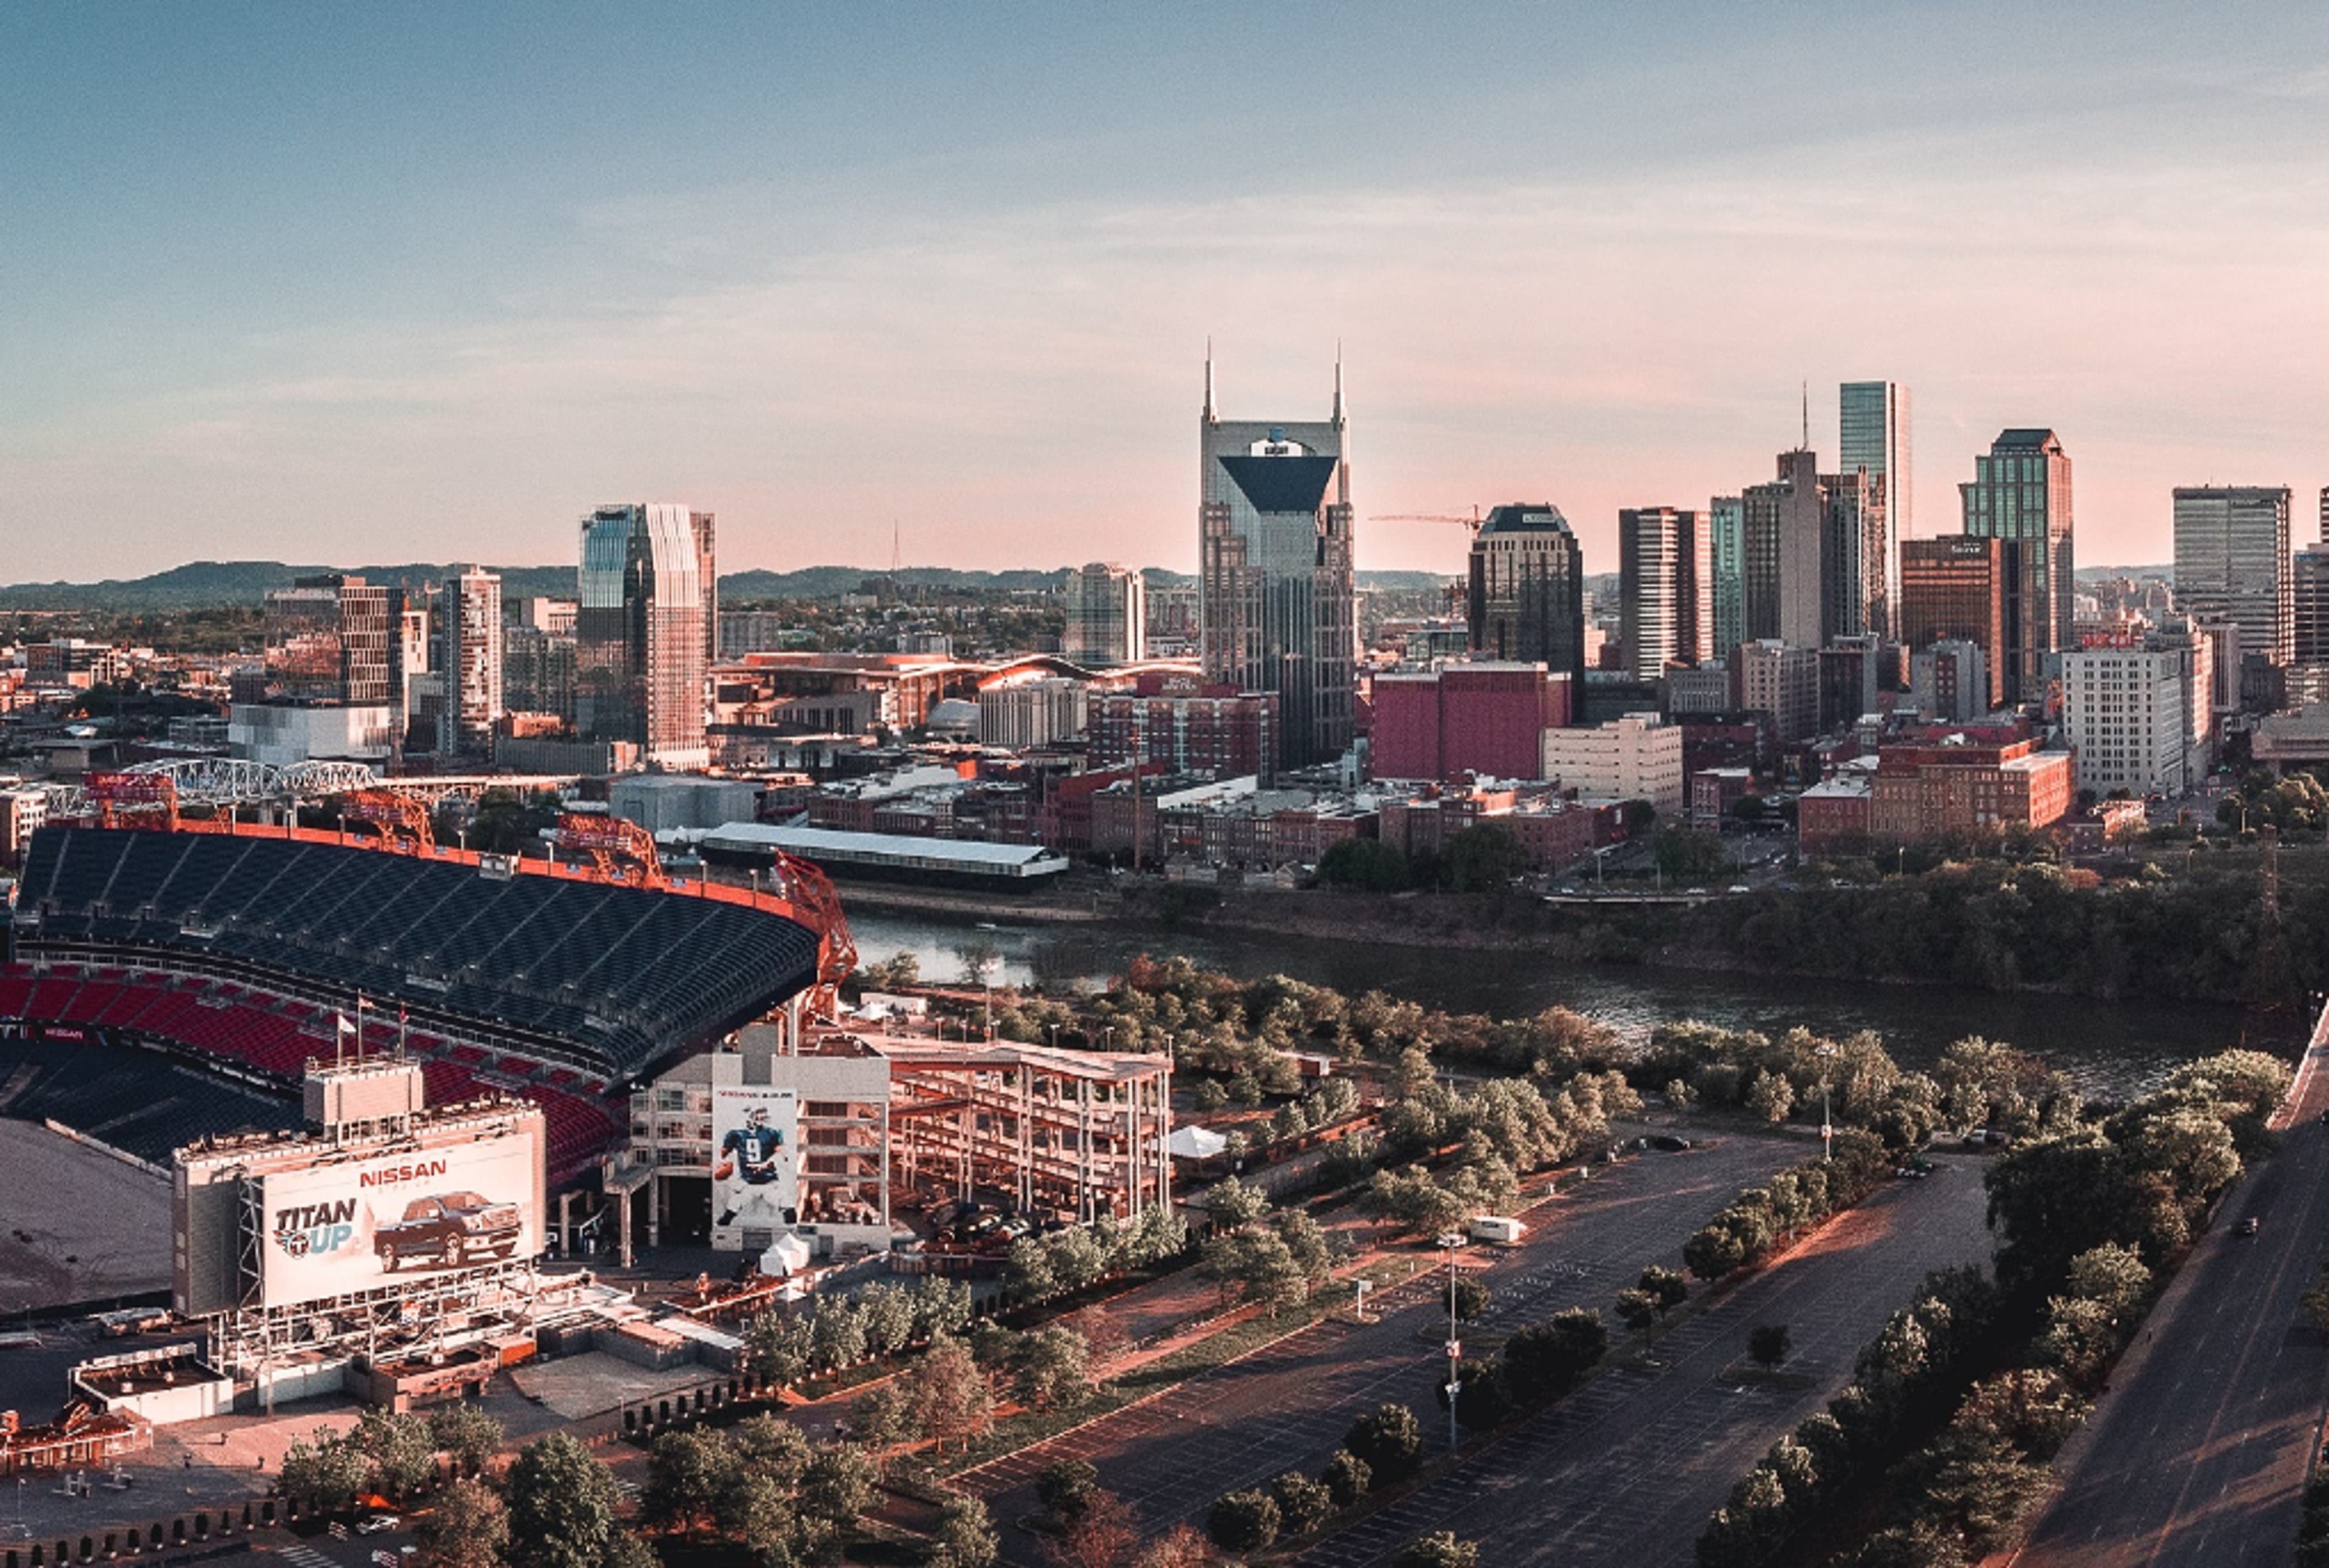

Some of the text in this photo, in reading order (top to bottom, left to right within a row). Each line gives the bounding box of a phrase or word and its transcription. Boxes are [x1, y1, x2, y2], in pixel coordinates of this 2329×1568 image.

[747, 1139, 761, 1162] 9
[360, 1159, 446, 1187] NISSAN
[276, 1198, 357, 1231] TITAN
[311, 1225, 352, 1253] UP
